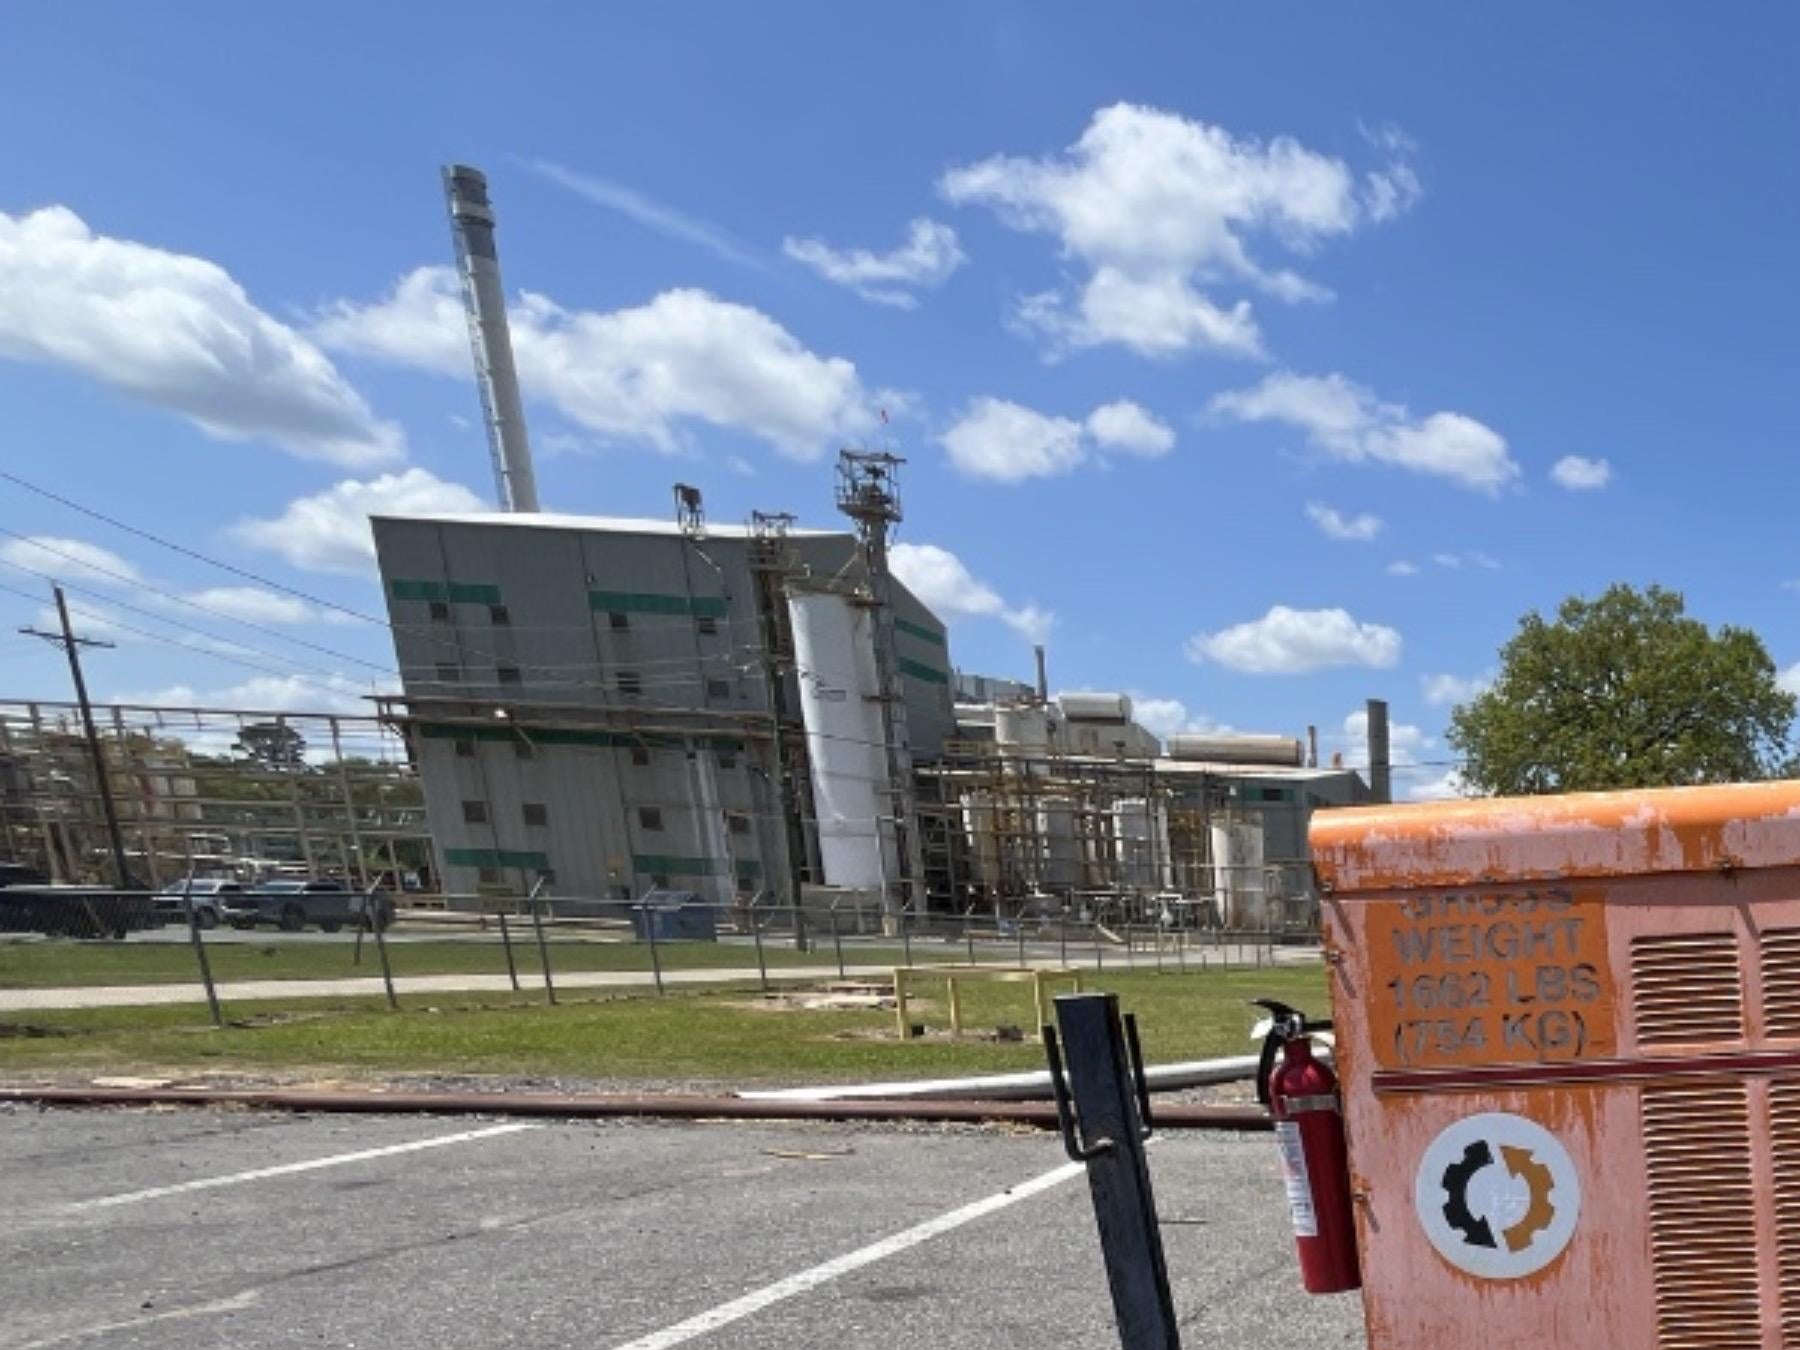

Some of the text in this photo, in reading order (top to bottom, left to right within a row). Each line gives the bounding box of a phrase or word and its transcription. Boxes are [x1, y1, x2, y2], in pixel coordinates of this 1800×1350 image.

[1392, 917, 1585, 966] WEIGHT
[1506, 962, 1602, 1006] LBS
[1501, 1009, 1588, 1058] KG)
